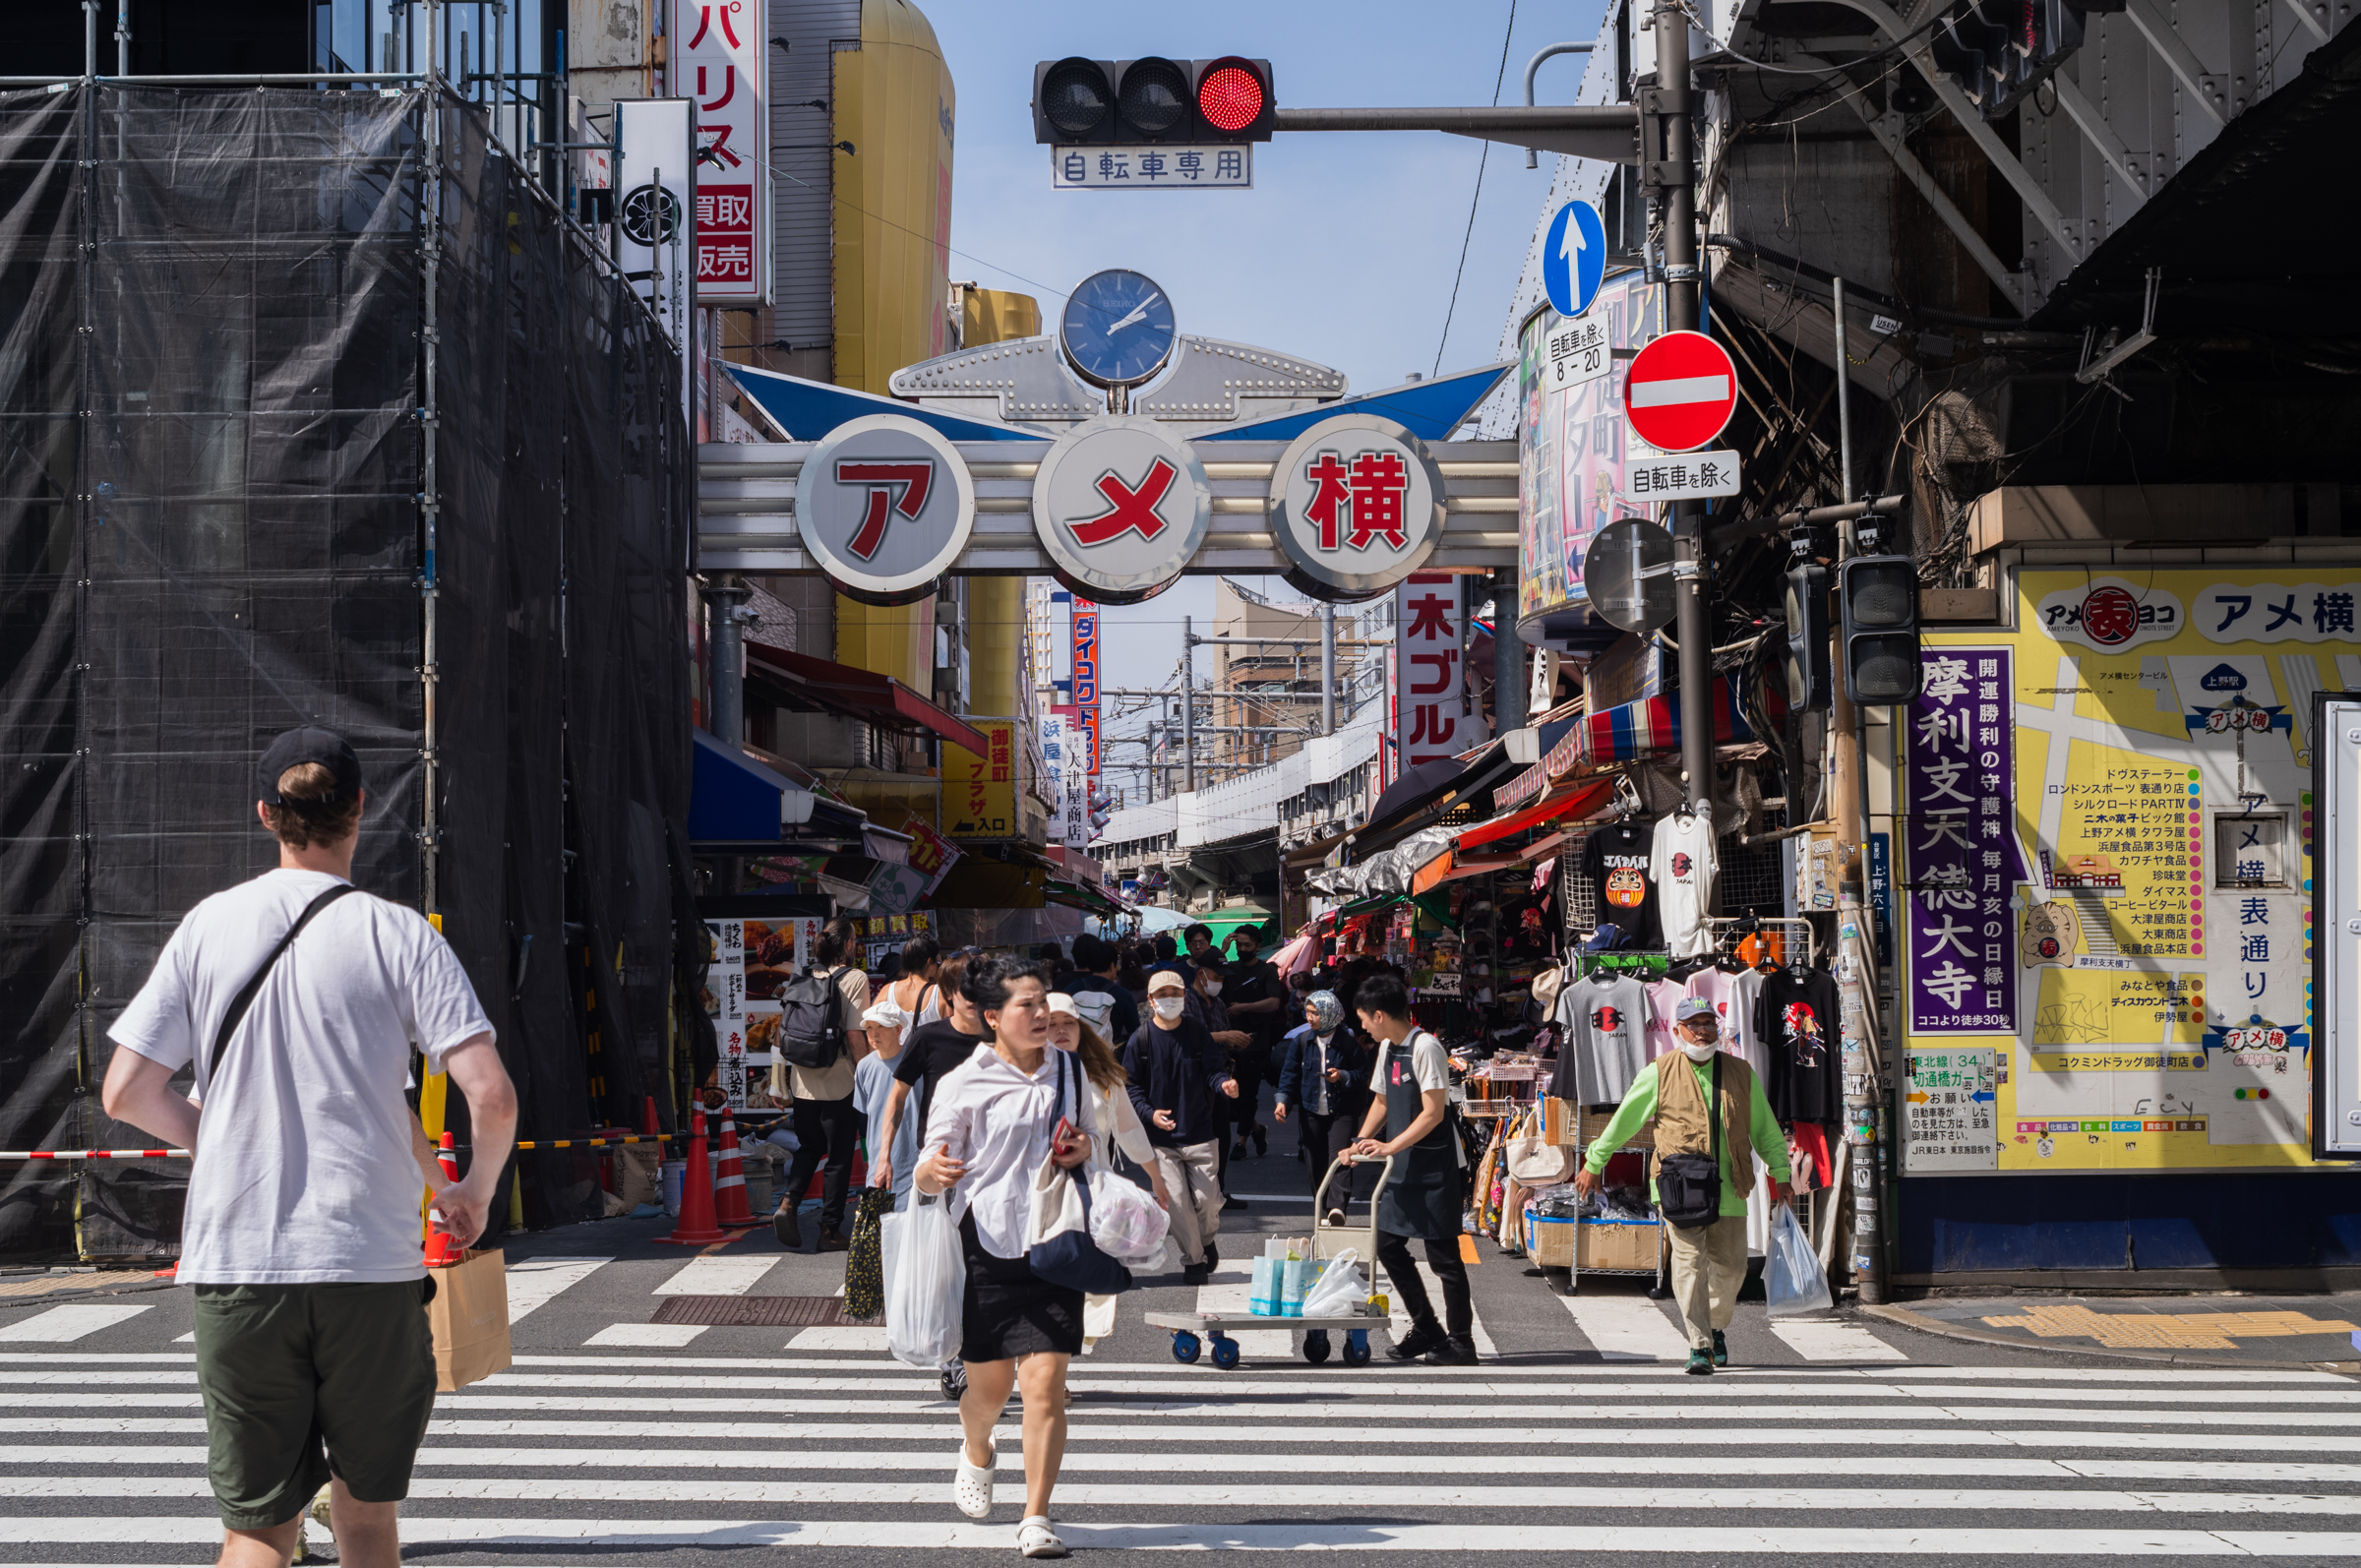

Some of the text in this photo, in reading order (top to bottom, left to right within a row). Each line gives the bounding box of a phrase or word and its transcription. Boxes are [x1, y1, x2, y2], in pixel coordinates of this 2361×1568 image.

[689, 0, 742, 169] パリス
[1064, 151, 1241, 181] 自転車専用
[696, 195, 750, 227] 買取
[1877, 320, 1897, 331] USEN
[1550, 323, 1604, 359] 自転車を除く
[1633, 462, 1730, 494] 自転車を除く
[2214, 592, 2355, 633] アメ横
[1075, 616, 1095, 703] ダイコク
[1407, 574, 1458, 765] 木ゴル
[2099, 671, 2168, 681] アメ横センタービル
[991, 729, 1009, 783] 御徒町
[1044, 720, 1060, 805] 浜屋食
[2107, 769, 2185, 780] ドヴステーラー
[969, 760, 987, 817] プラザ
[2048, 783, 2185, 795] ロンドンスポーツ 表通り店
[1066, 752, 1081, 841] 大津屋商店
[2073, 799, 2138, 810] シルクロード
[977, 817, 1005, 832] 入口
[1917, 656, 1978, 1010] 摩利支天徳大寺
[1978, 658, 2004, 1009] 開運勝利の守護神 毎月亥の日縁日
[2080, 827, 2186, 838] 上野アメ横 タワラ屋
[2097, 841, 2187, 853] 浜屋食品第3号店
[1604, 855, 1649, 871] JAPAN
[2119, 855, 2187, 866] カワチヤ食品
[2152, 870, 2187, 881] 珍味堂
[2143, 885, 2188, 897] ダイマス
[2109, 900, 2188, 910] コーヒービタール
[2130, 914, 2187, 925] 大津屋商店
[2142, 929, 2187, 940] 大東商店
[2119, 942, 2188, 954] 浜屋食品本店
[2080, 957, 2133, 969] 摩利支天横丁
[2120, 980, 2188, 992] みなとや食品
[2111, 996, 2189, 1007] ディスカウント二木
[1590, 1008, 1625, 1029] 日本
[1918, 1015, 2010, 1028] ココより徒歩30秒
[2153, 1011, 2188, 1023] 伊勢屋
[2227, 1030, 2284, 1048] アメ横
[2058, 1056, 2190, 1069] コクミンドラッグ御徒町店
[1929, 1093, 1971, 1105] お願い
[1911, 1107, 1988, 1118] 自動車等がした
[1911, 1118, 1990, 1129] のを見た方は、至急
[2084, 1122, 2106, 1131] 衣料
[2146, 1122, 2169, 1131] 貴金属
[2180, 1121, 2202, 1131] 飲食
[1911, 1130, 1968, 1141] 御連絡下さい。
[1912, 1146, 1946, 1155] JR東日本
